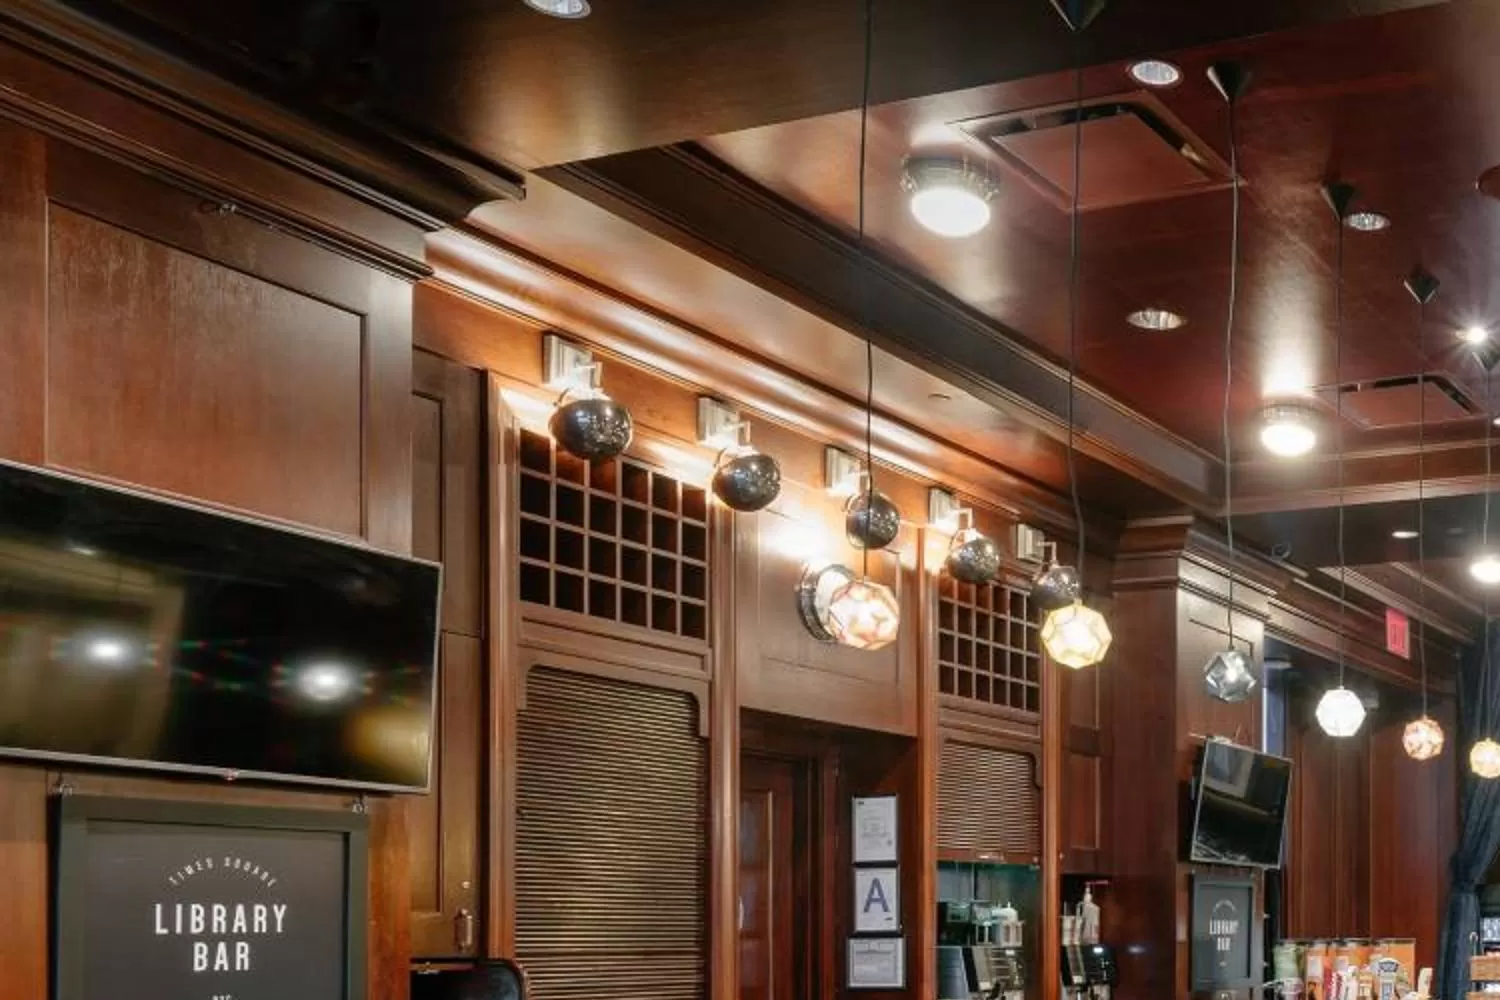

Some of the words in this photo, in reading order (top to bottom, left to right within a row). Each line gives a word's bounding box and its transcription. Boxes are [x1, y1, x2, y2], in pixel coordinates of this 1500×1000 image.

[168, 857, 213, 885] TIMES
[224, 857, 277, 887] SQUARE
[863, 877, 891, 913] A
[155, 903, 287, 934] LIBRARY
[193, 941, 250, 972] BAR
